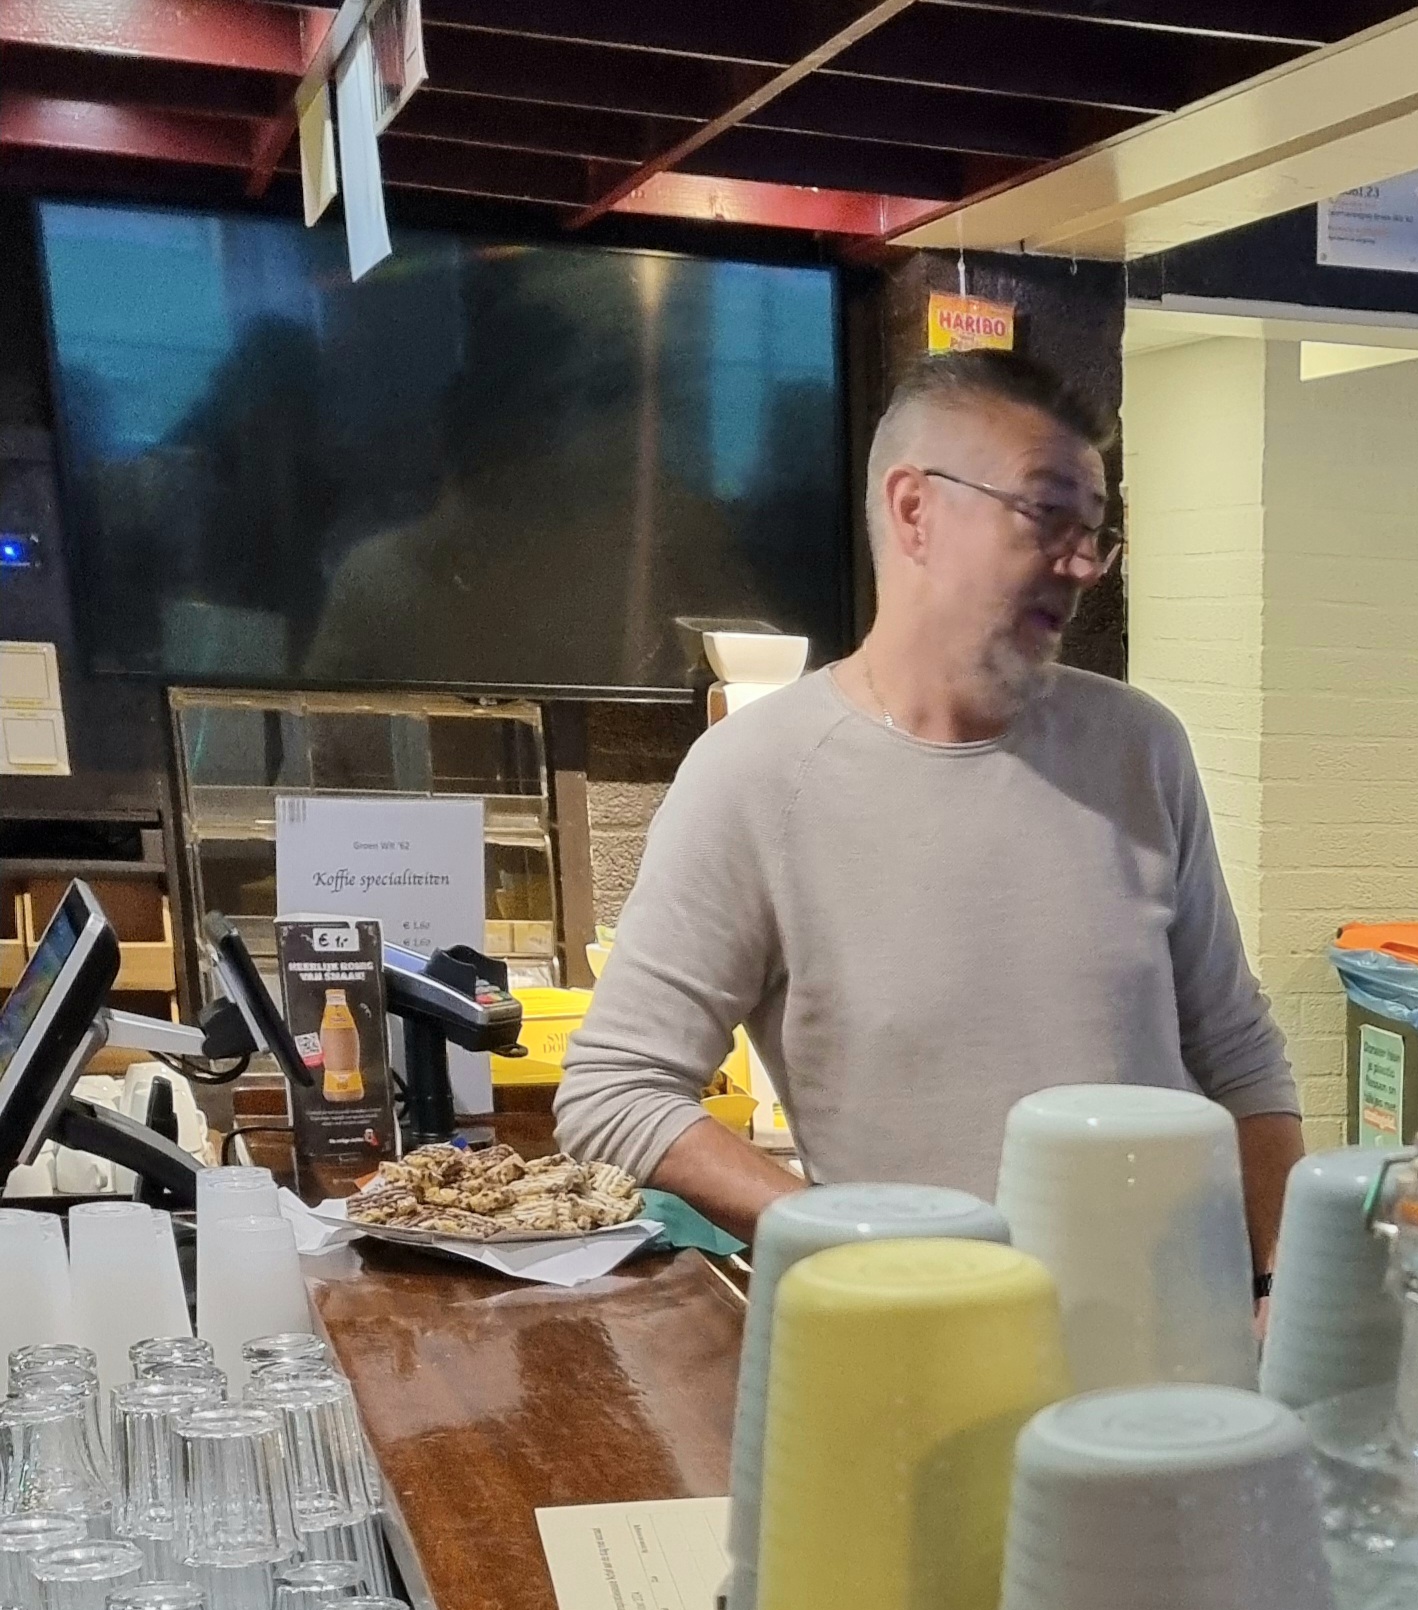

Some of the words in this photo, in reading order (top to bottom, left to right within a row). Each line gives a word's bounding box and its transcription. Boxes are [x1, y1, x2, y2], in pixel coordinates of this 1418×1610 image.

[939, 311, 1006, 336] HARIBO
[313, 868, 355, 893] Koffie
[360, 868, 450, 893] specialiteiten
[319, 933, 330, 947] €
